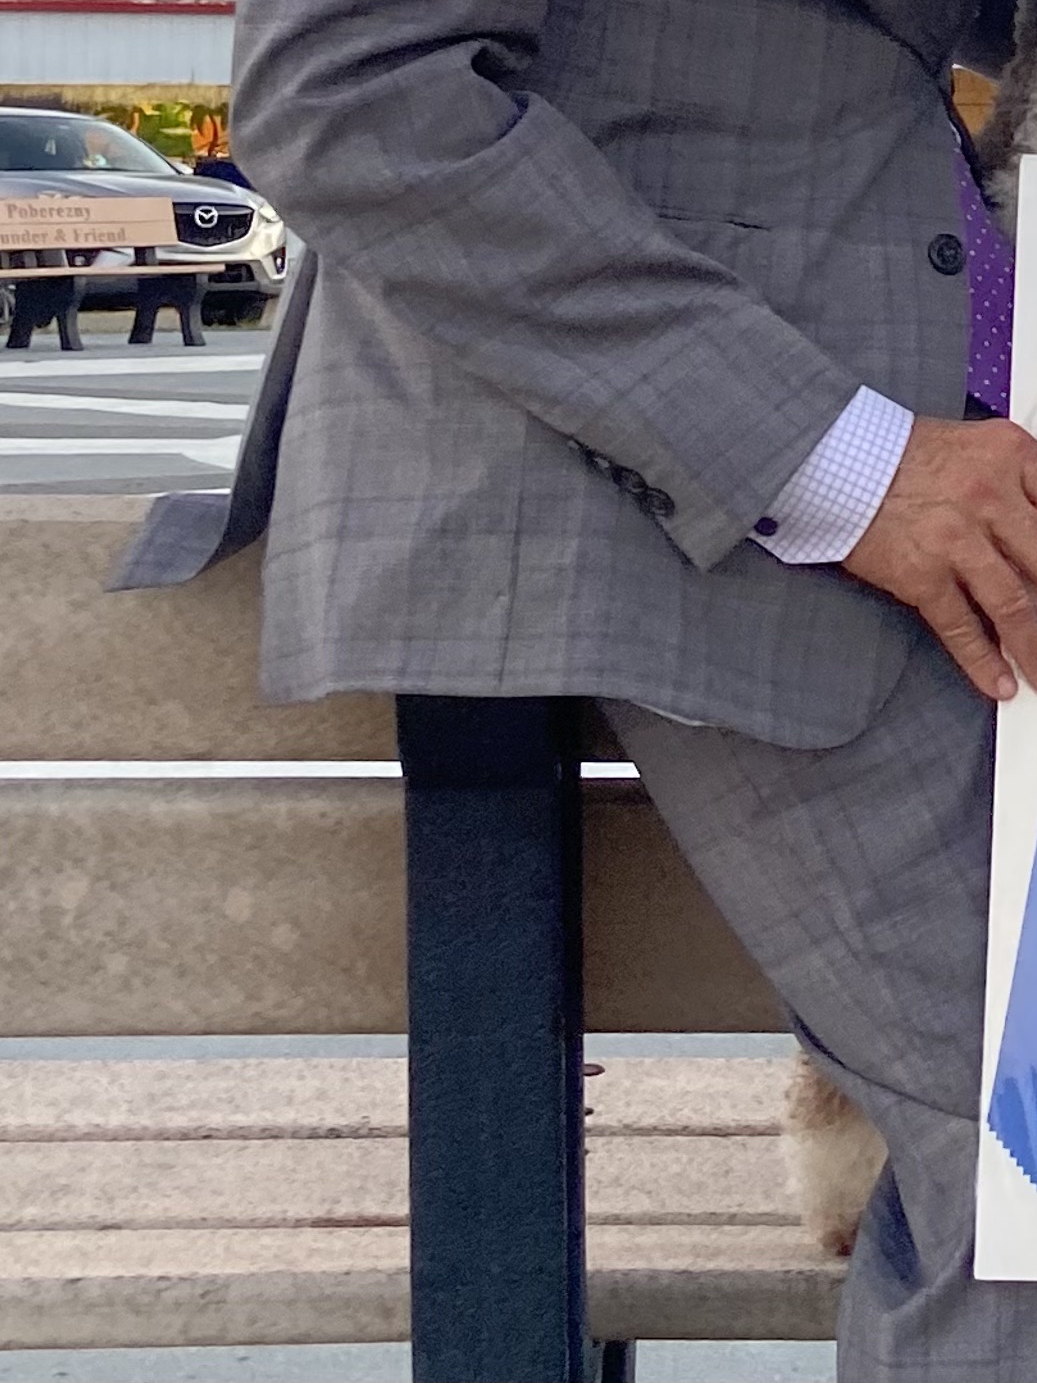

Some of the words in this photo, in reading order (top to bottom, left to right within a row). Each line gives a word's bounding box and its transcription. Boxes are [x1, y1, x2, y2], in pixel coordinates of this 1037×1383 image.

[7, 203, 91, 221] Poberezny
[54, 228, 67, 243] &
[73, 227, 127, 243] Friend
